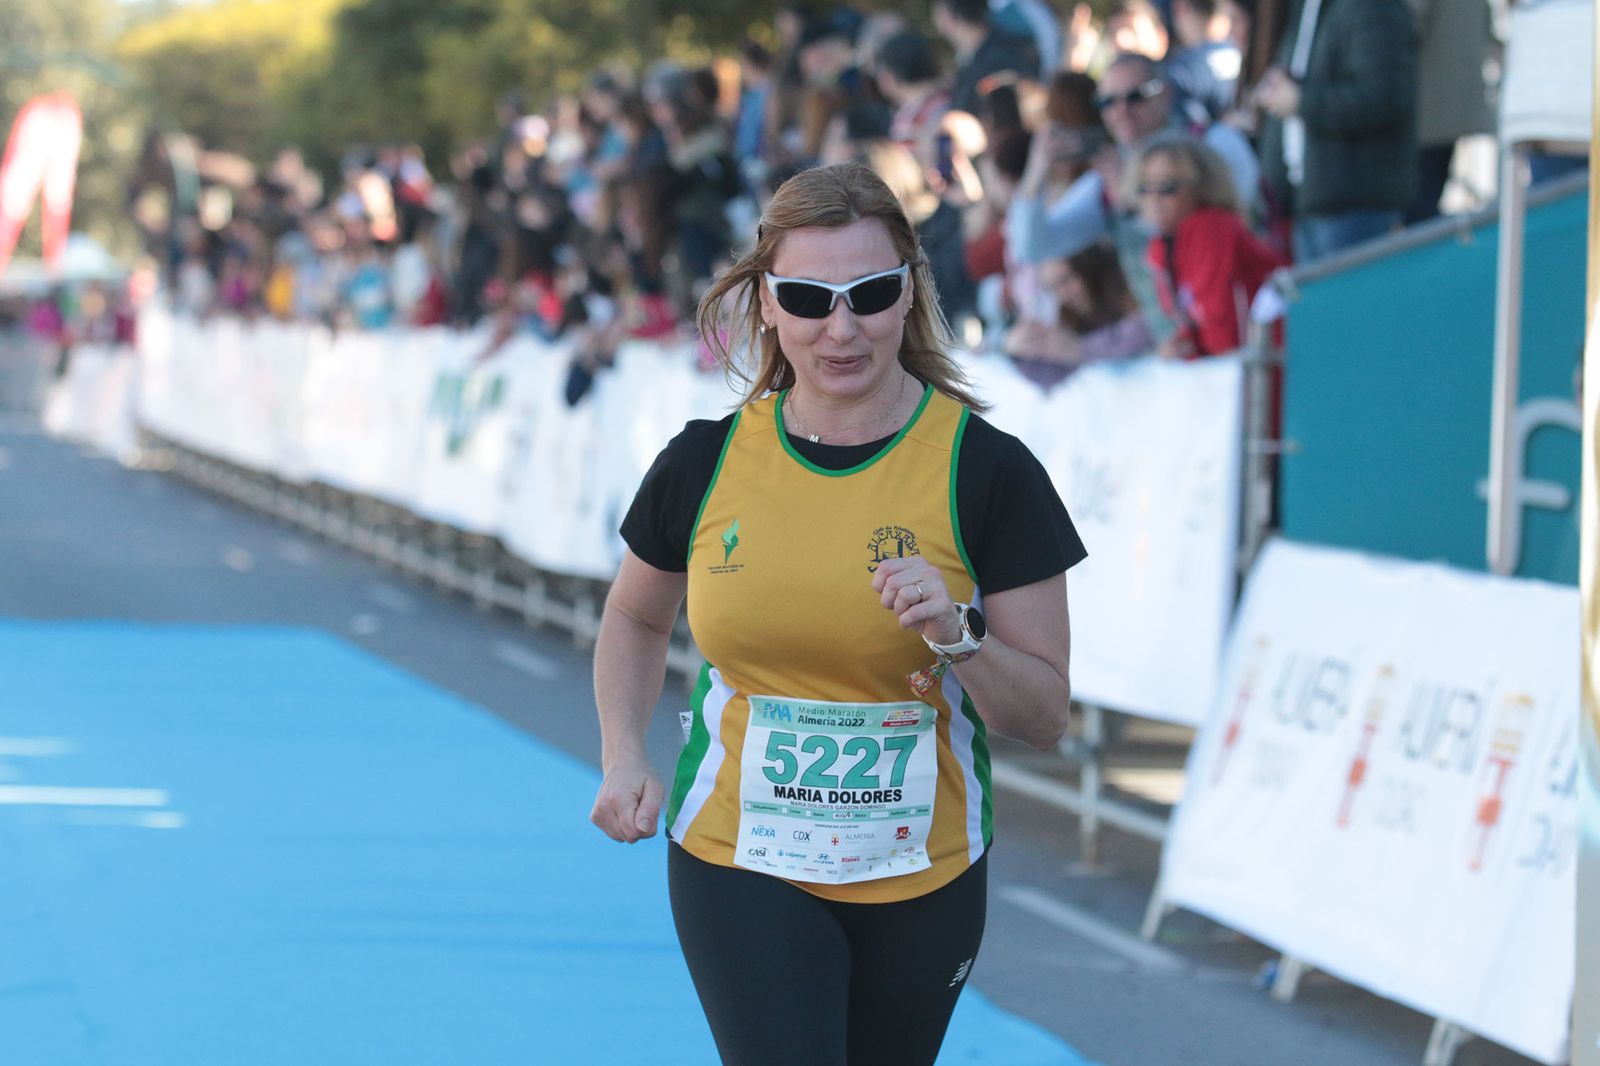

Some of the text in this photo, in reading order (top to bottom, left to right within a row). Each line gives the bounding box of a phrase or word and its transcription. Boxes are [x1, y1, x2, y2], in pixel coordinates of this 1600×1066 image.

[798, 706, 867, 718] Medio Maratón
[797, 715, 836, 727] Almería
[761, 730, 919, 790] 5227
[774, 785, 903, 805] MARIA DOLORES
[751, 826, 776, 838] NEXA
